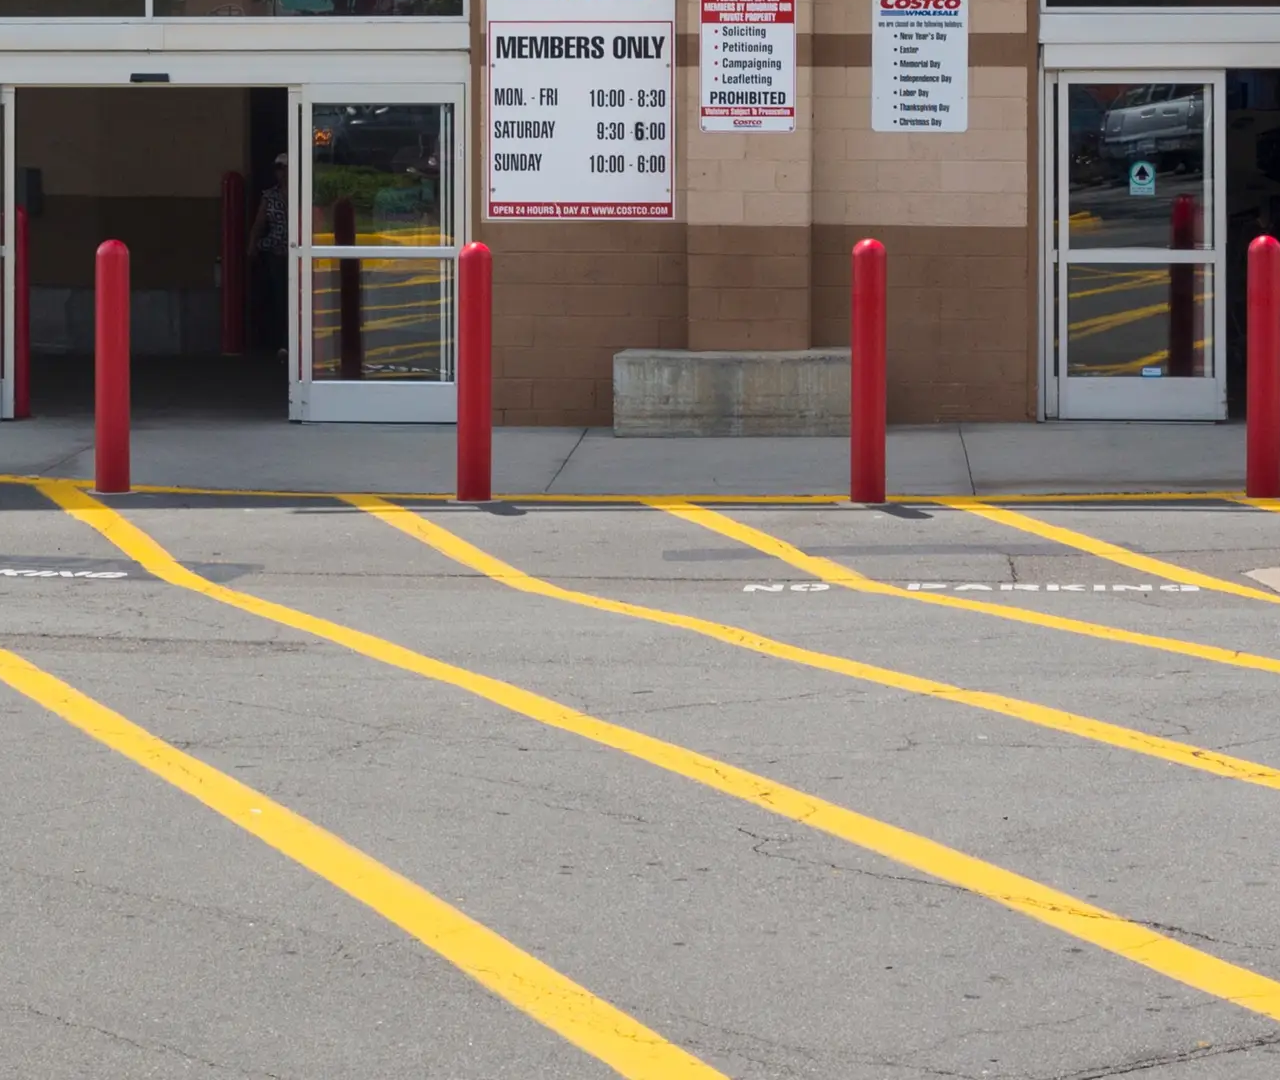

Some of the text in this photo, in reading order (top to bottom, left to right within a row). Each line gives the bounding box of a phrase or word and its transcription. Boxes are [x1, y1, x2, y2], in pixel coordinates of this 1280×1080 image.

[722, 26, 766, 38] Soliciting
[900, 32, 947, 41] New Year's Day
[496, 36, 665, 59] MEMBERS ONLY
[722, 42, 773, 54] Petitioning
[900, 46, 919, 54] Easter
[722, 58, 782, 70] Campaigning
[930, 60, 941, 69] Day
[722, 74, 772, 86] Leafletting
[900, 74, 952, 84] Independence Day
[494, 88, 527, 106] MON.
[540, 88, 558, 106] FRI
[589, 89, 625, 107] 10:00
[637, 89, 666, 107] 8:30
[710, 91, 786, 105] PROHIBITED
[899, 88, 929, 98] Labor Day
[900, 103, 950, 112] Thanksgiving Day
[899, 118, 942, 127] Christmas Day
[494, 121, 556, 139] SATURDAY
[597, 122, 625, 140] 9:30
[634, 121, 666, 141] 6:00
[494, 153, 543, 171] SUNDAY
[589, 155, 625, 173] 10:00
[637, 155, 666, 173] 6:00
[493, 206, 514, 215] OPEN
[516, 206, 525, 215] 24
[527, 206, 554, 215] HOURS
[563, 206, 579, 215] DAY
[580, 206, 590, 215] AT
[592, 206, 669, 215] WWW.COSTCO.COM
[742, 582, 1202, 592] NO PARKING
